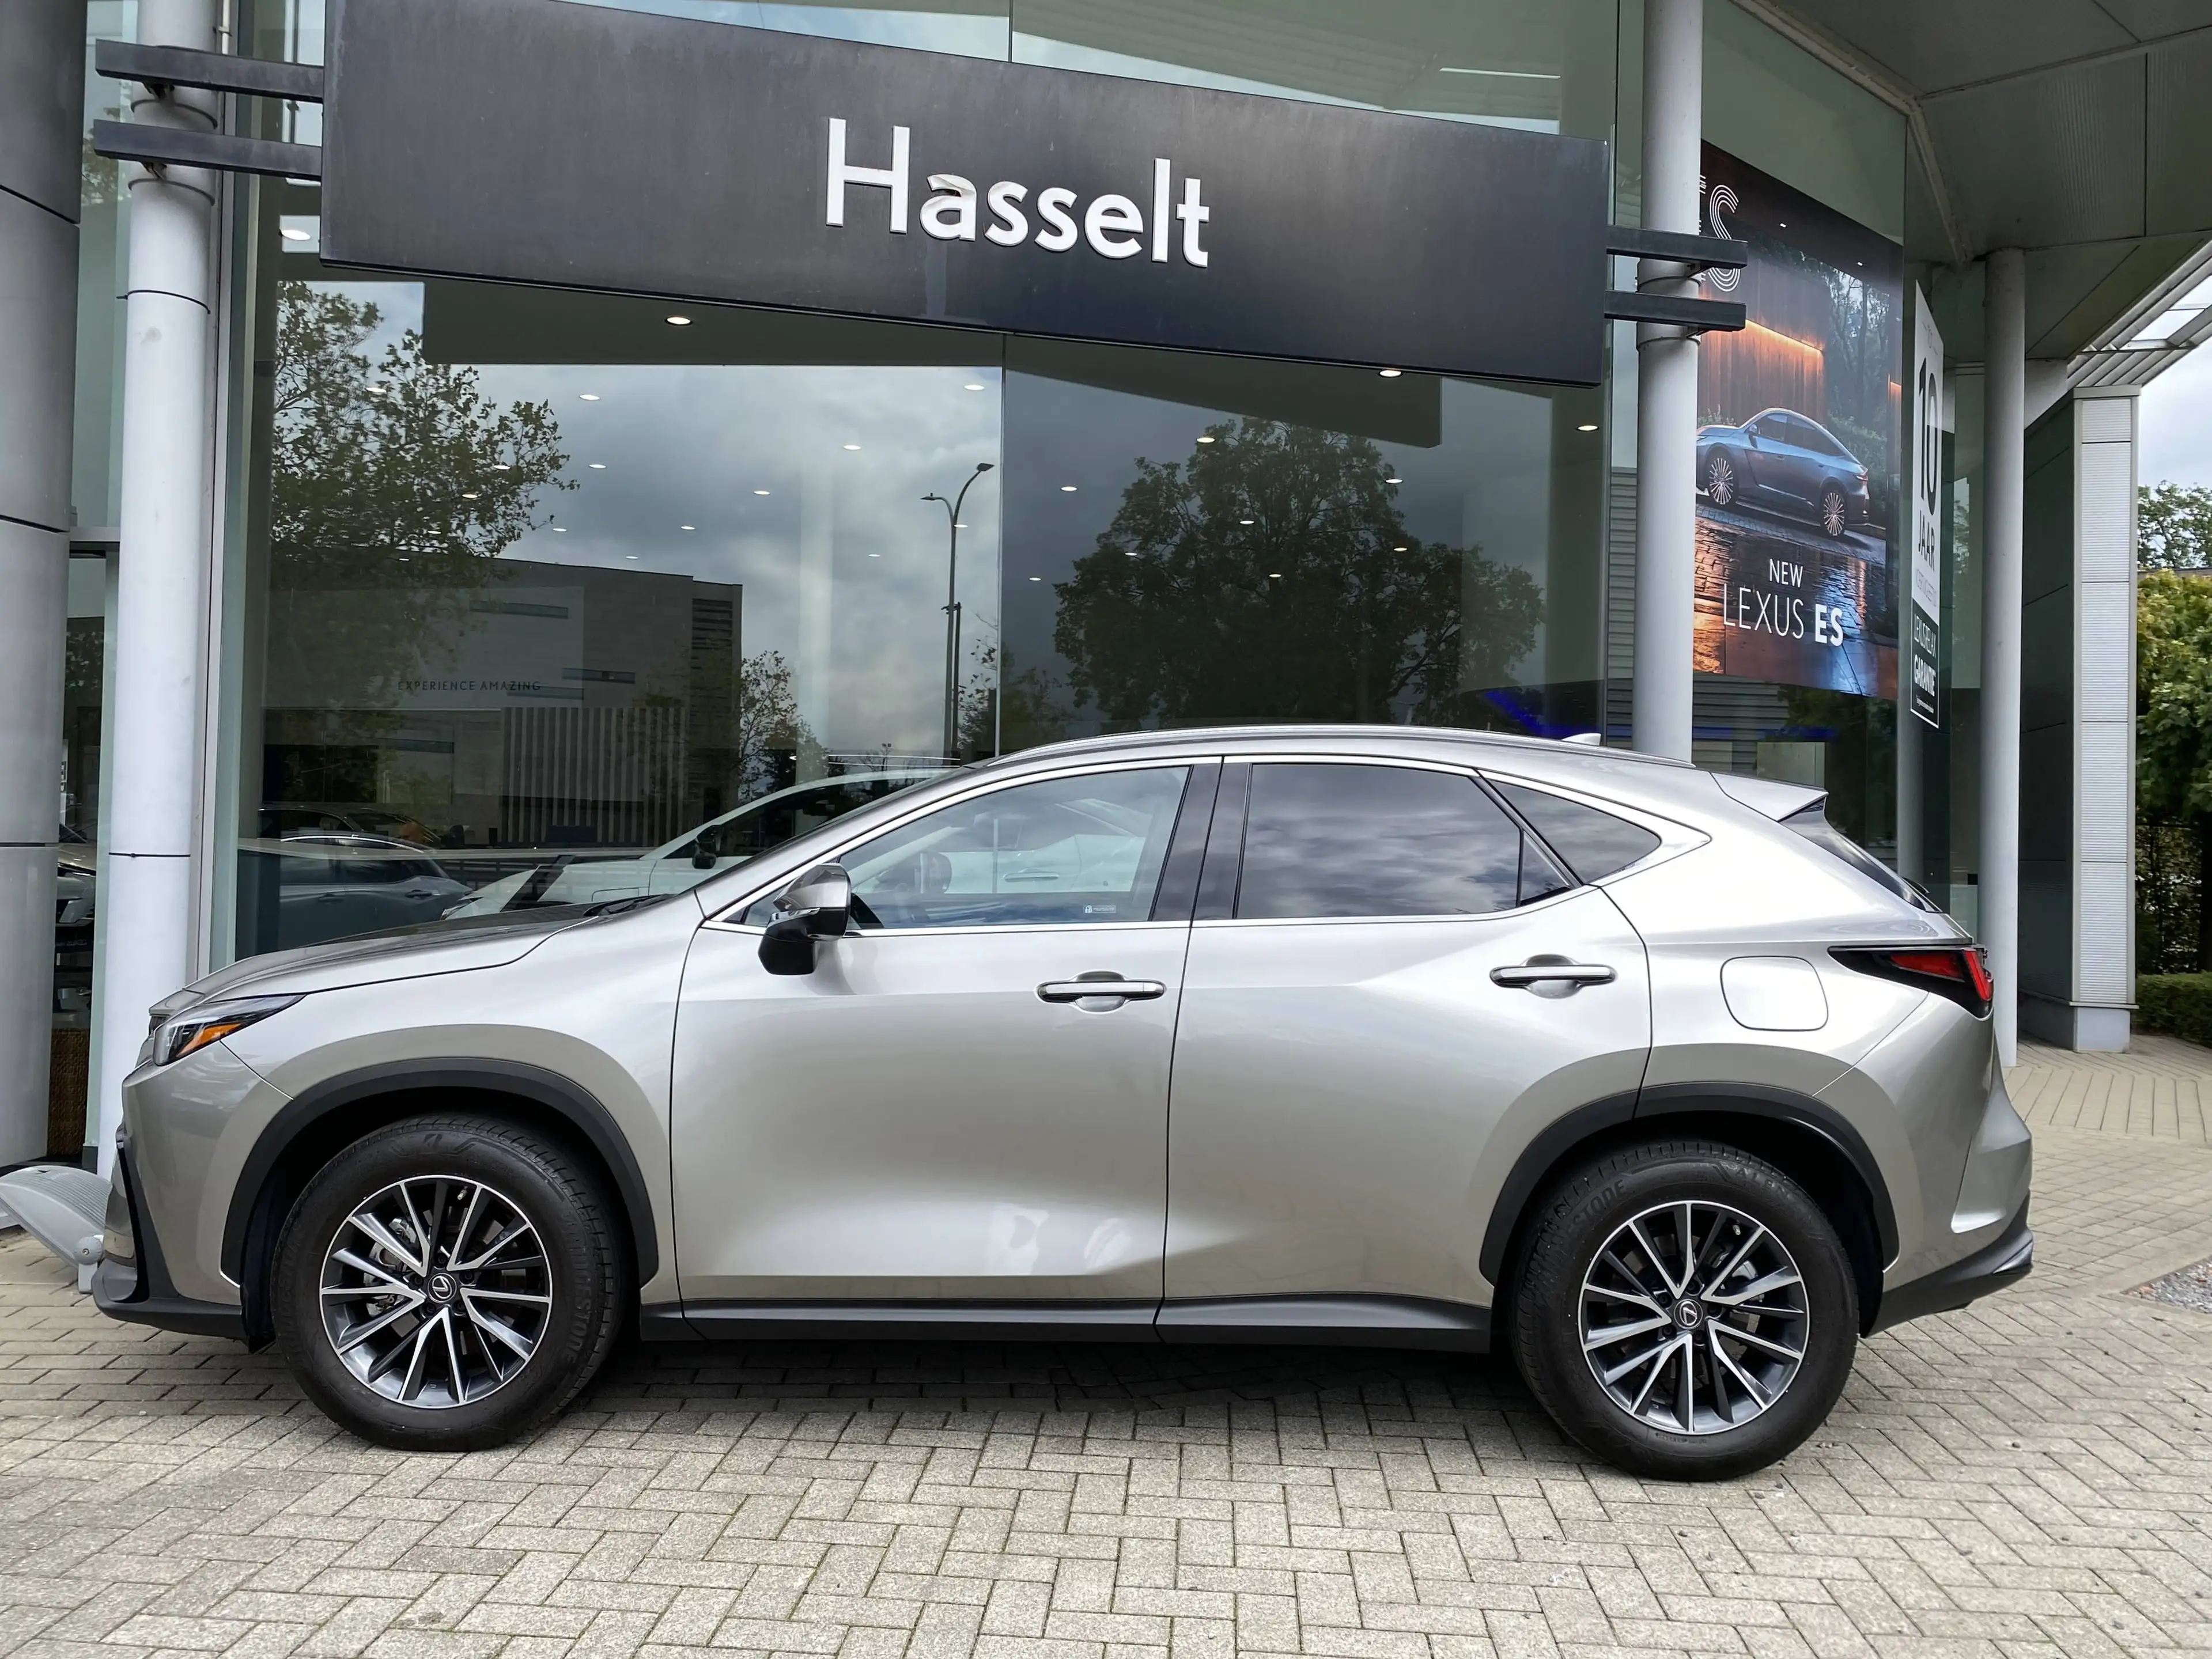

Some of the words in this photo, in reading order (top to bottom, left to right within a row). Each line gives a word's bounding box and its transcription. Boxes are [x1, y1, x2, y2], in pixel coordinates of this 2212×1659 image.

[825, 116, 1211, 268] Hasselt
[1919, 357, 1938, 516] 10
[1769, 558, 1803, 588] NEW
[1918, 510, 1936, 573] JAAR
[1722, 583, 1805, 640] LEXUS
[1814, 603, 1844, 647] ES
[398, 680, 475, 691] EXPERIENCE
[480, 680, 541, 691] AMAZING
